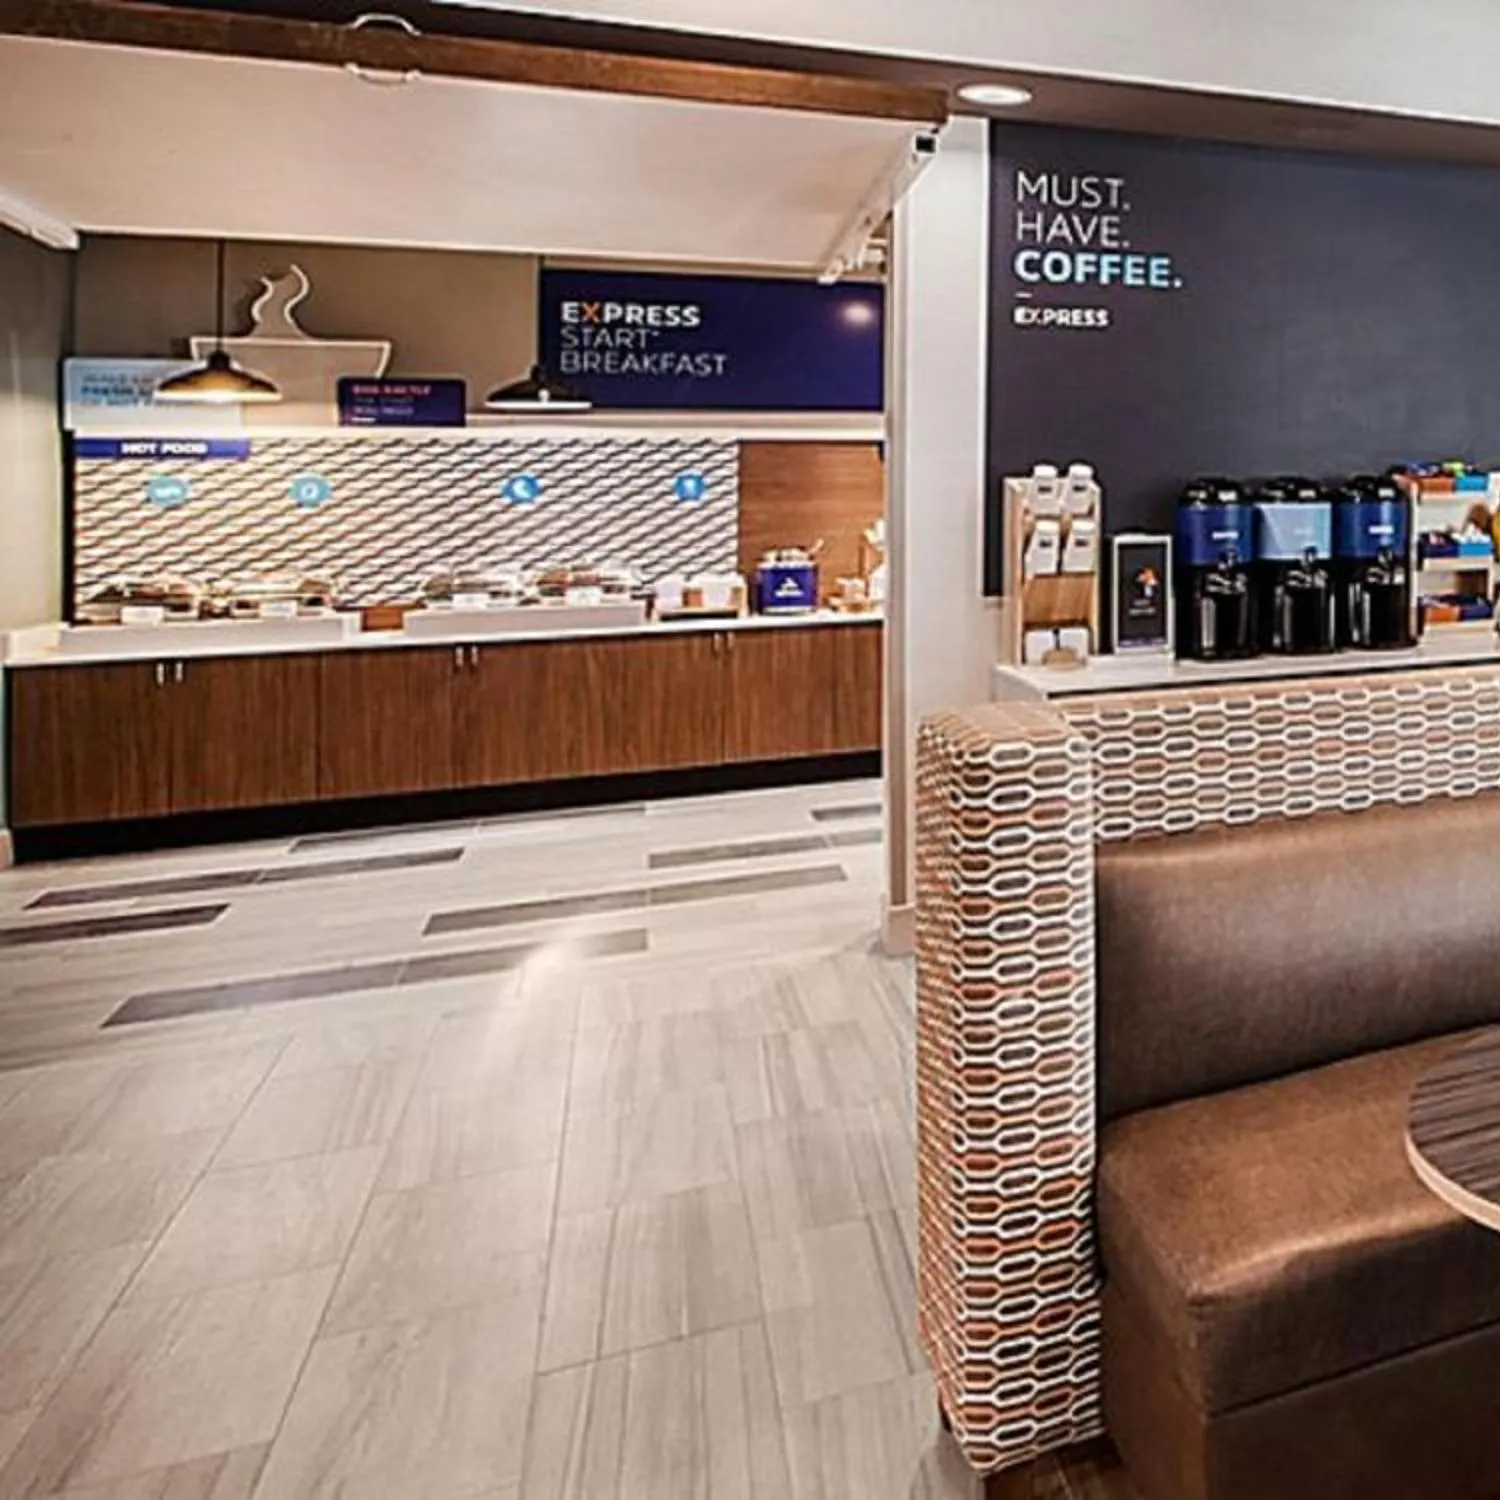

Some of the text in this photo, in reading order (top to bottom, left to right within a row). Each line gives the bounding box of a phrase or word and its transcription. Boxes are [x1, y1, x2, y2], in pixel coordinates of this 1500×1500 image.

[1016, 169, 1131, 211] MUST.
[1015, 211, 1131, 249] HAVE.
[1014, 250, 1183, 289] COFFEE.
[561, 301, 701, 327] EXPRESS
[1013, 305, 1110, 327] EXPRESS
[559, 350, 727, 377] BREAKFAST
[121, 442, 156, 454] HOT
